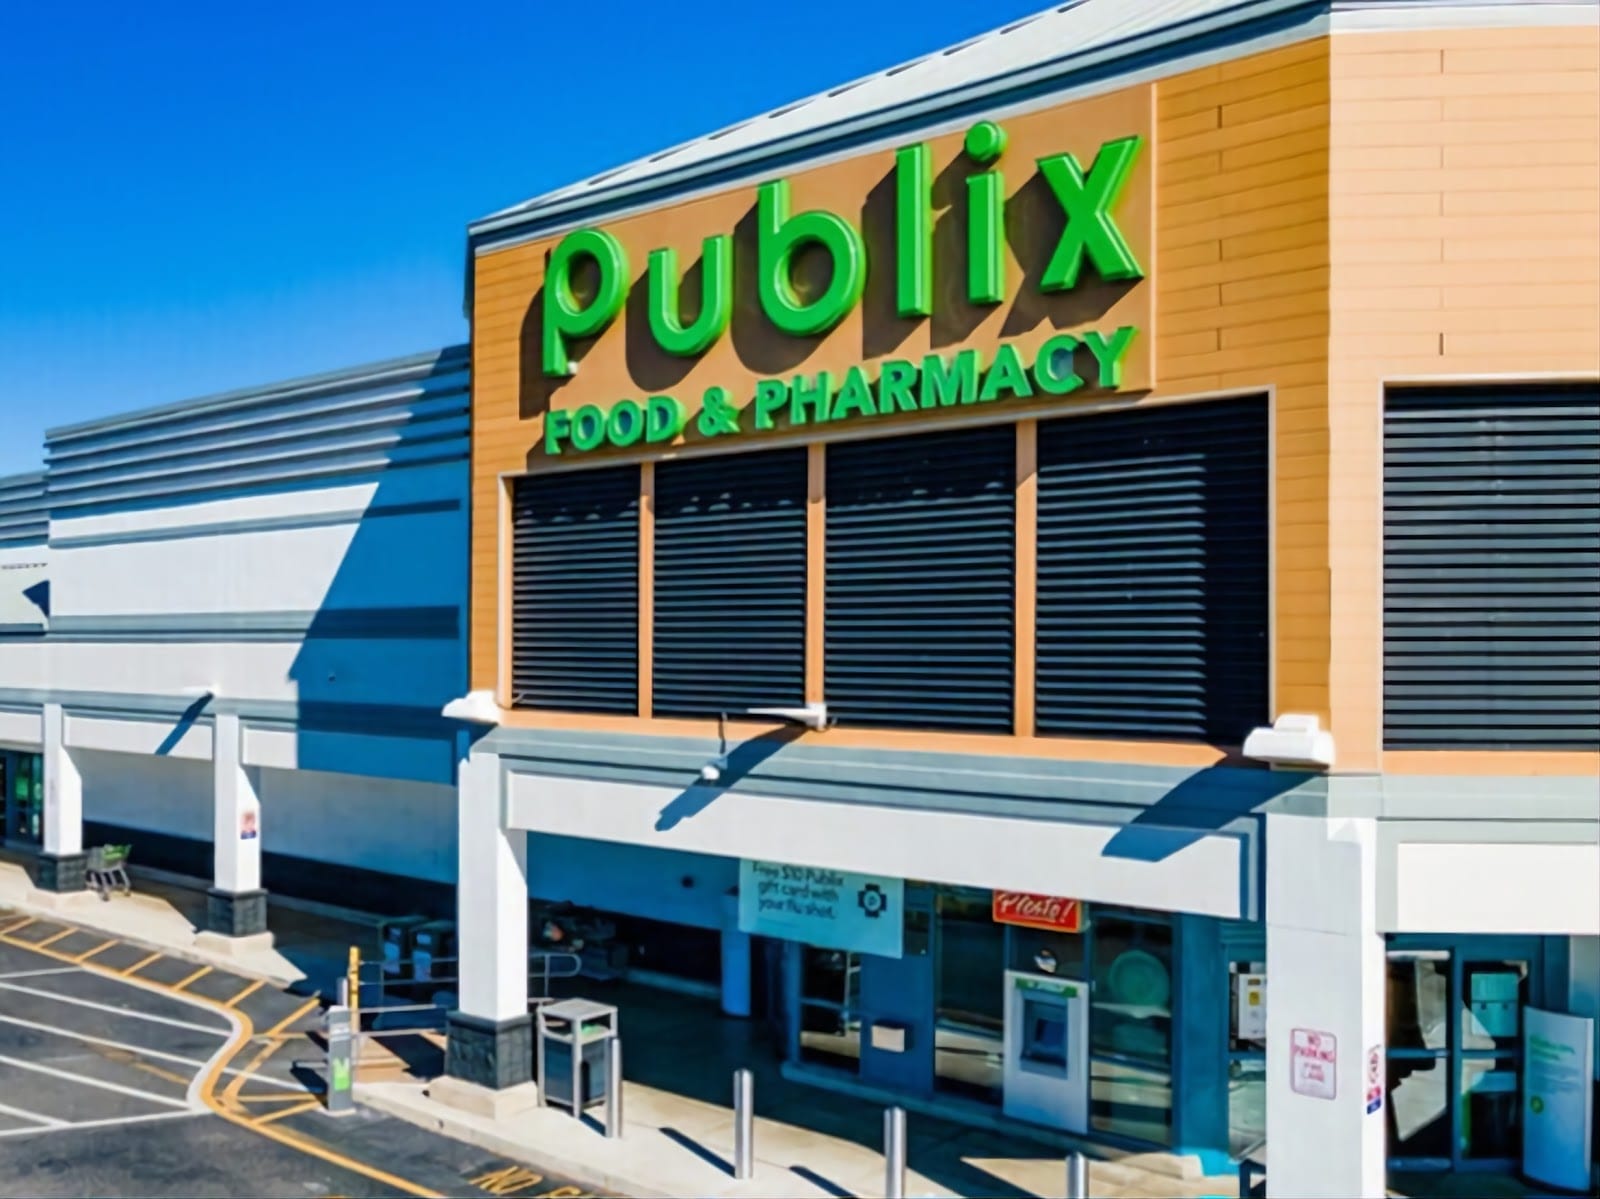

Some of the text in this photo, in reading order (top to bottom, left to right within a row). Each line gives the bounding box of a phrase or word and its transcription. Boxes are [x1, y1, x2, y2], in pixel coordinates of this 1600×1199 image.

[542, 120, 1145, 377] Publix
[545, 325, 1139, 455] FOOD & PHARMACY
[468, 1165, 543, 1195] NO
